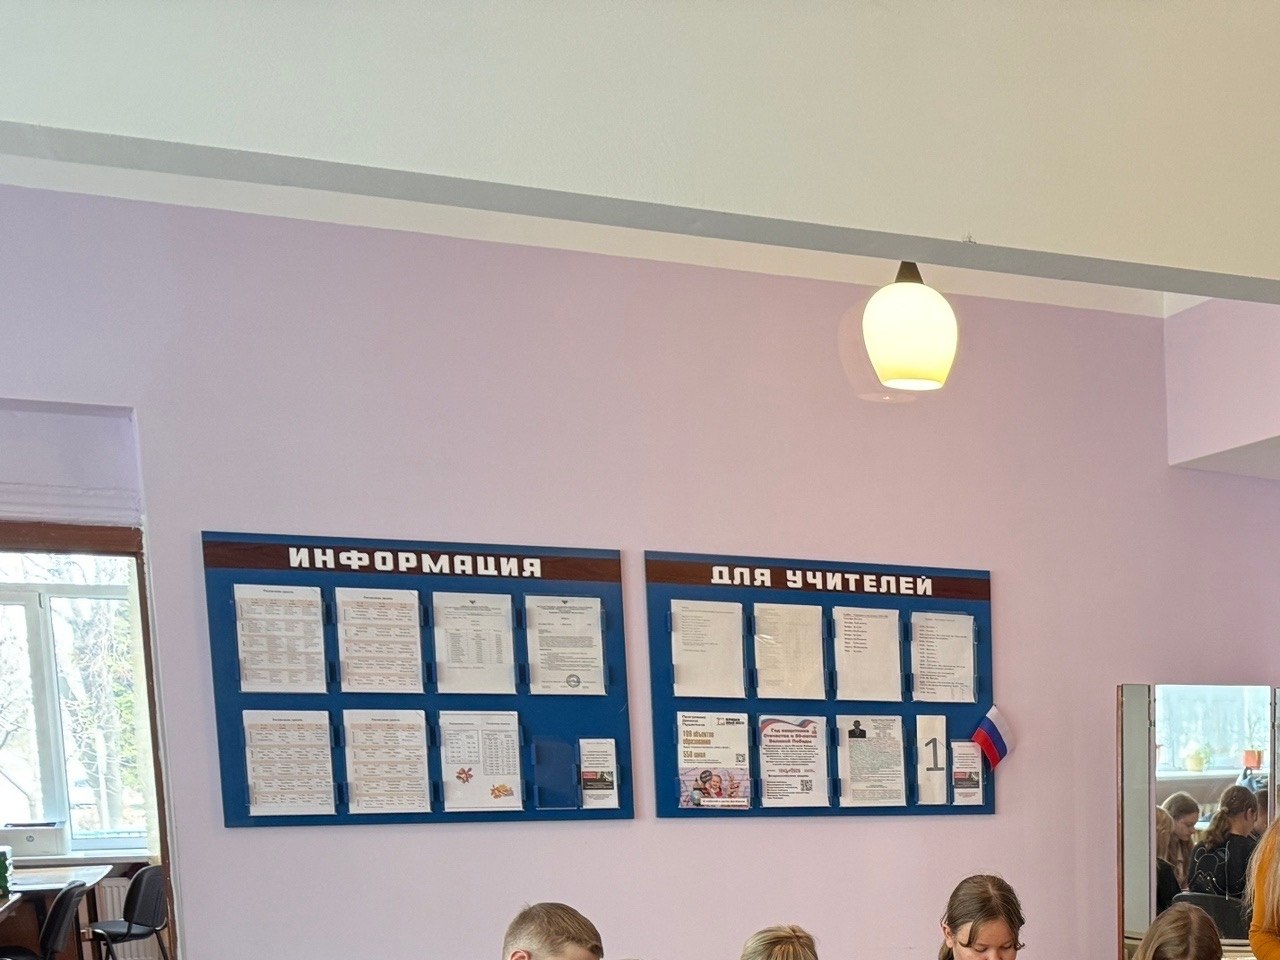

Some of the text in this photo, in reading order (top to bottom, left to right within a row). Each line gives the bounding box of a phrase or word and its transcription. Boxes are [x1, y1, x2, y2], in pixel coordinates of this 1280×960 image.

[288, 547, 542, 578] ИНФОРМАЦИЯ
[711, 565, 933, 596] ДЛЯ УЧИТЕЛЕЙ
[925, 738, 945, 771] 1
